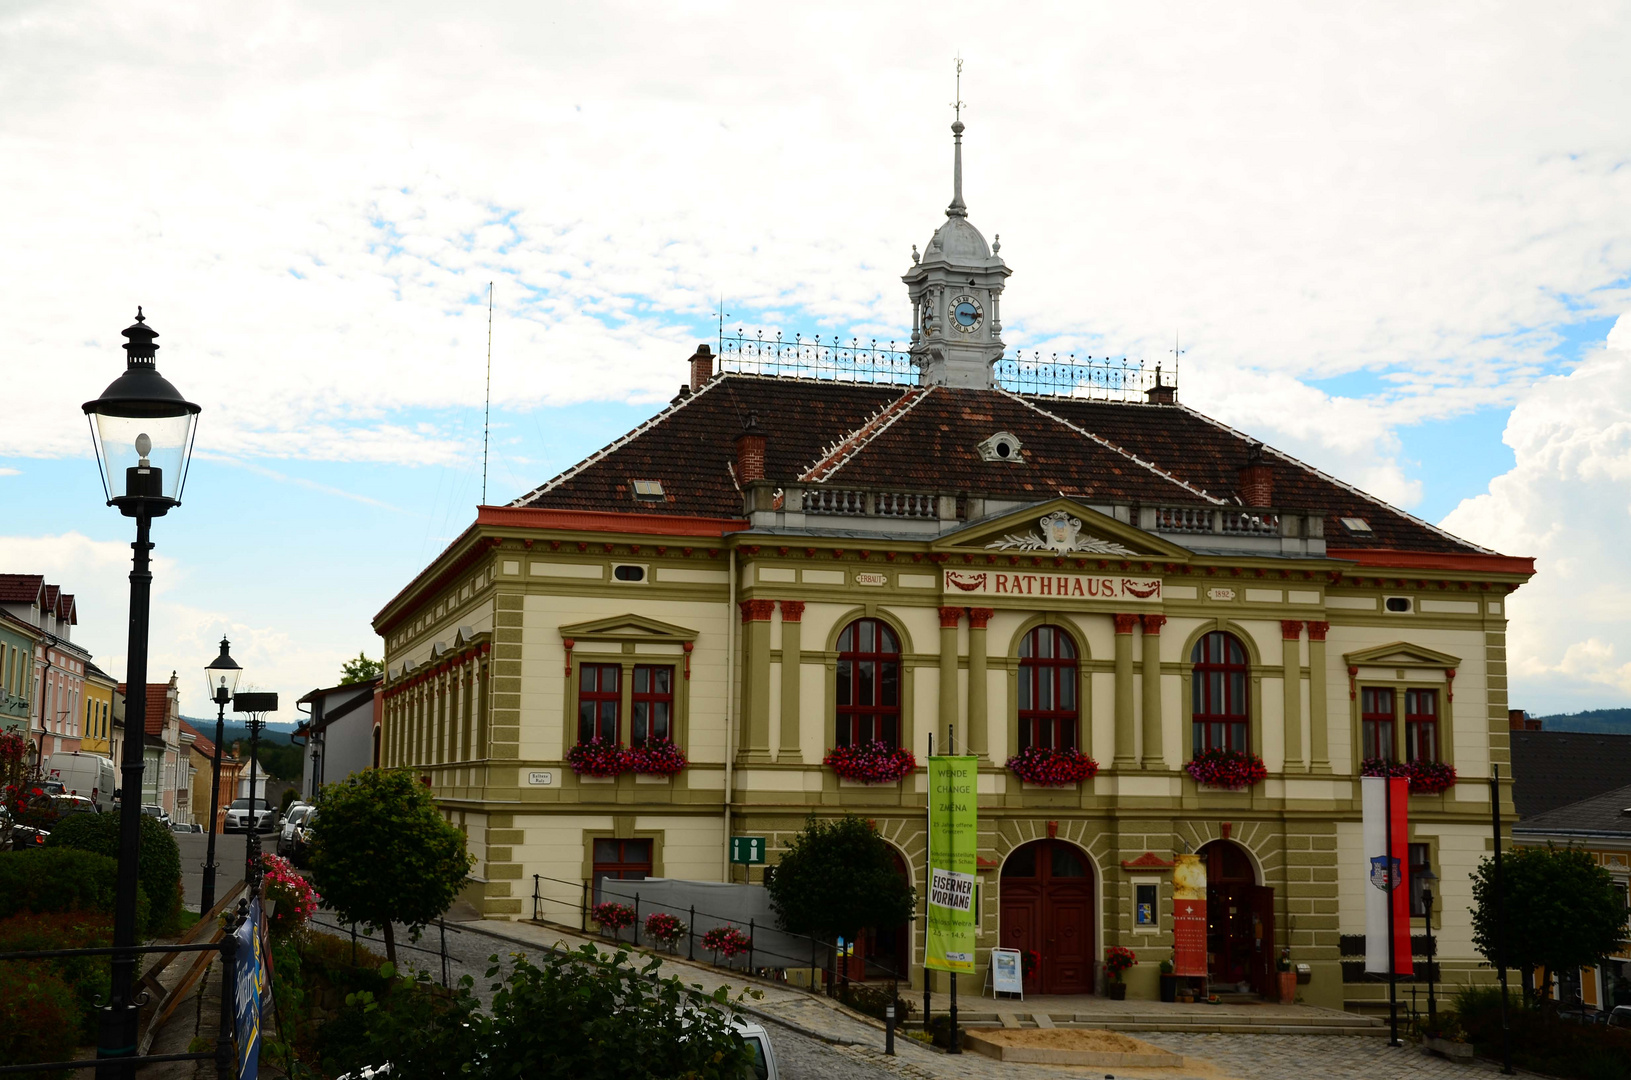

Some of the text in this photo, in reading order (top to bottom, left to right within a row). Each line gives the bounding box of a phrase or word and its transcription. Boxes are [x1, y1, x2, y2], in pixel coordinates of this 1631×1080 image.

[861, 575, 881, 583] ERBAUT
[996, 574, 1117, 597] RATHHAUS.
[938, 770, 968, 778] WENDE
[937, 785, 970, 793] CHANGE
[933, 875, 972, 895] EISERNER
[932, 889, 969, 909] VORHANG
